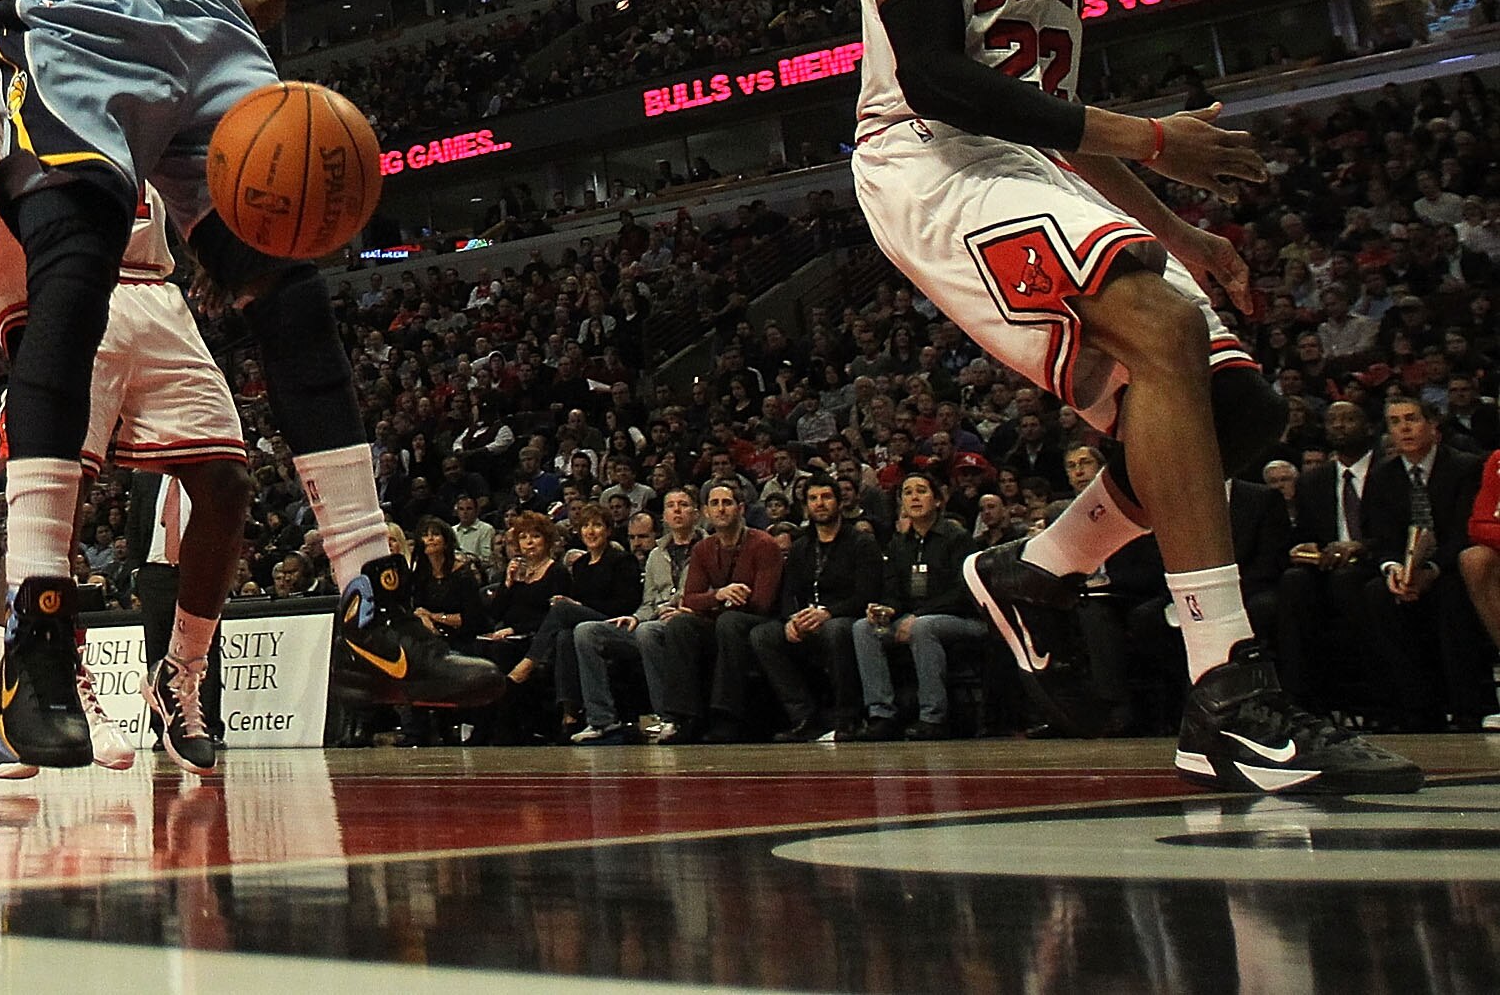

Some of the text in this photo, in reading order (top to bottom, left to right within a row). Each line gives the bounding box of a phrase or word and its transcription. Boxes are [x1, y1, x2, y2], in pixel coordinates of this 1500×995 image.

[643, 42, 864, 118] BULLS vs MEMP
[984, 19, 1074, 100] 22
[228, 711, 295, 732] Center
